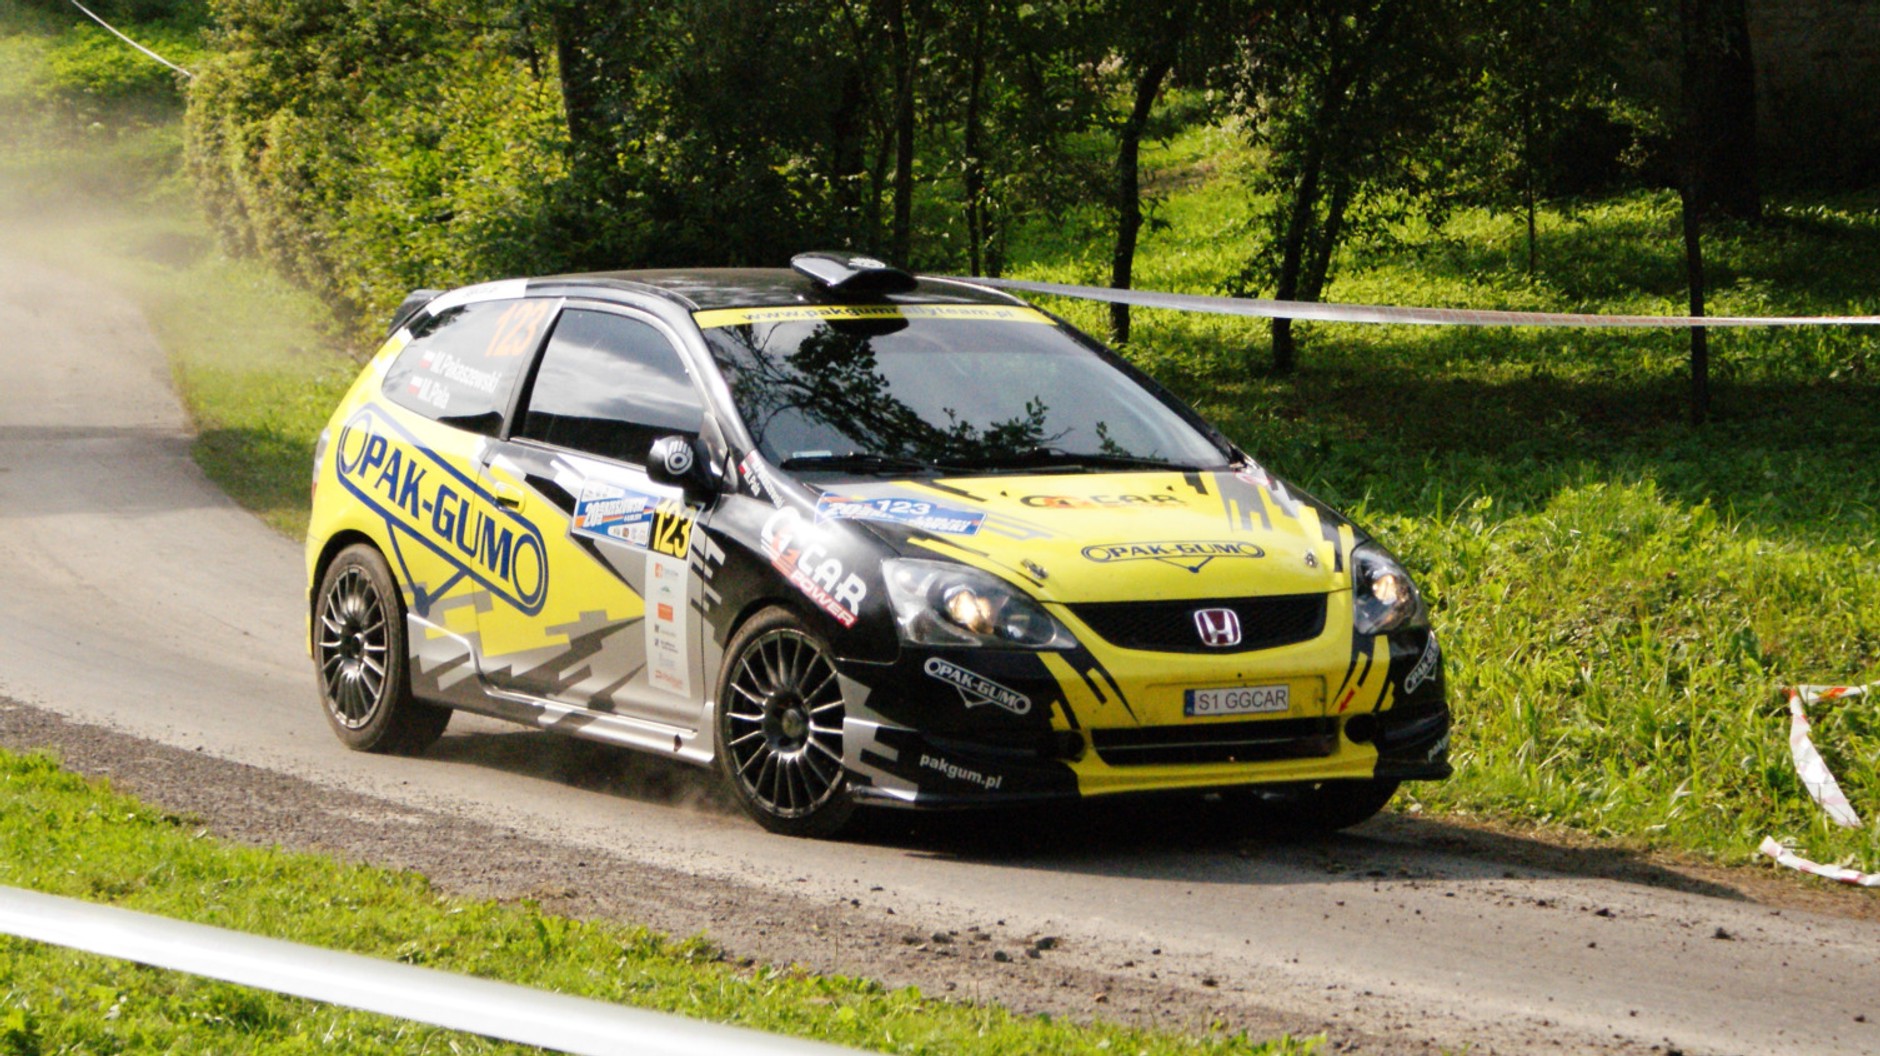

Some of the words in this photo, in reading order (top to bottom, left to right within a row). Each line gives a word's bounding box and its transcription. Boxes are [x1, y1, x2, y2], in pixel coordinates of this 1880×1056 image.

[484, 301, 549, 358] 123
[653, 500, 698, 559] 123
[880, 499, 931, 516] 123
[790, 569, 856, 628] POWER
[798, 543, 867, 617] CAR
[1199, 693, 1219, 711] S1
[1225, 689, 1287, 709] GGCAR
[919, 753, 1003, 790] pakgum.pl
